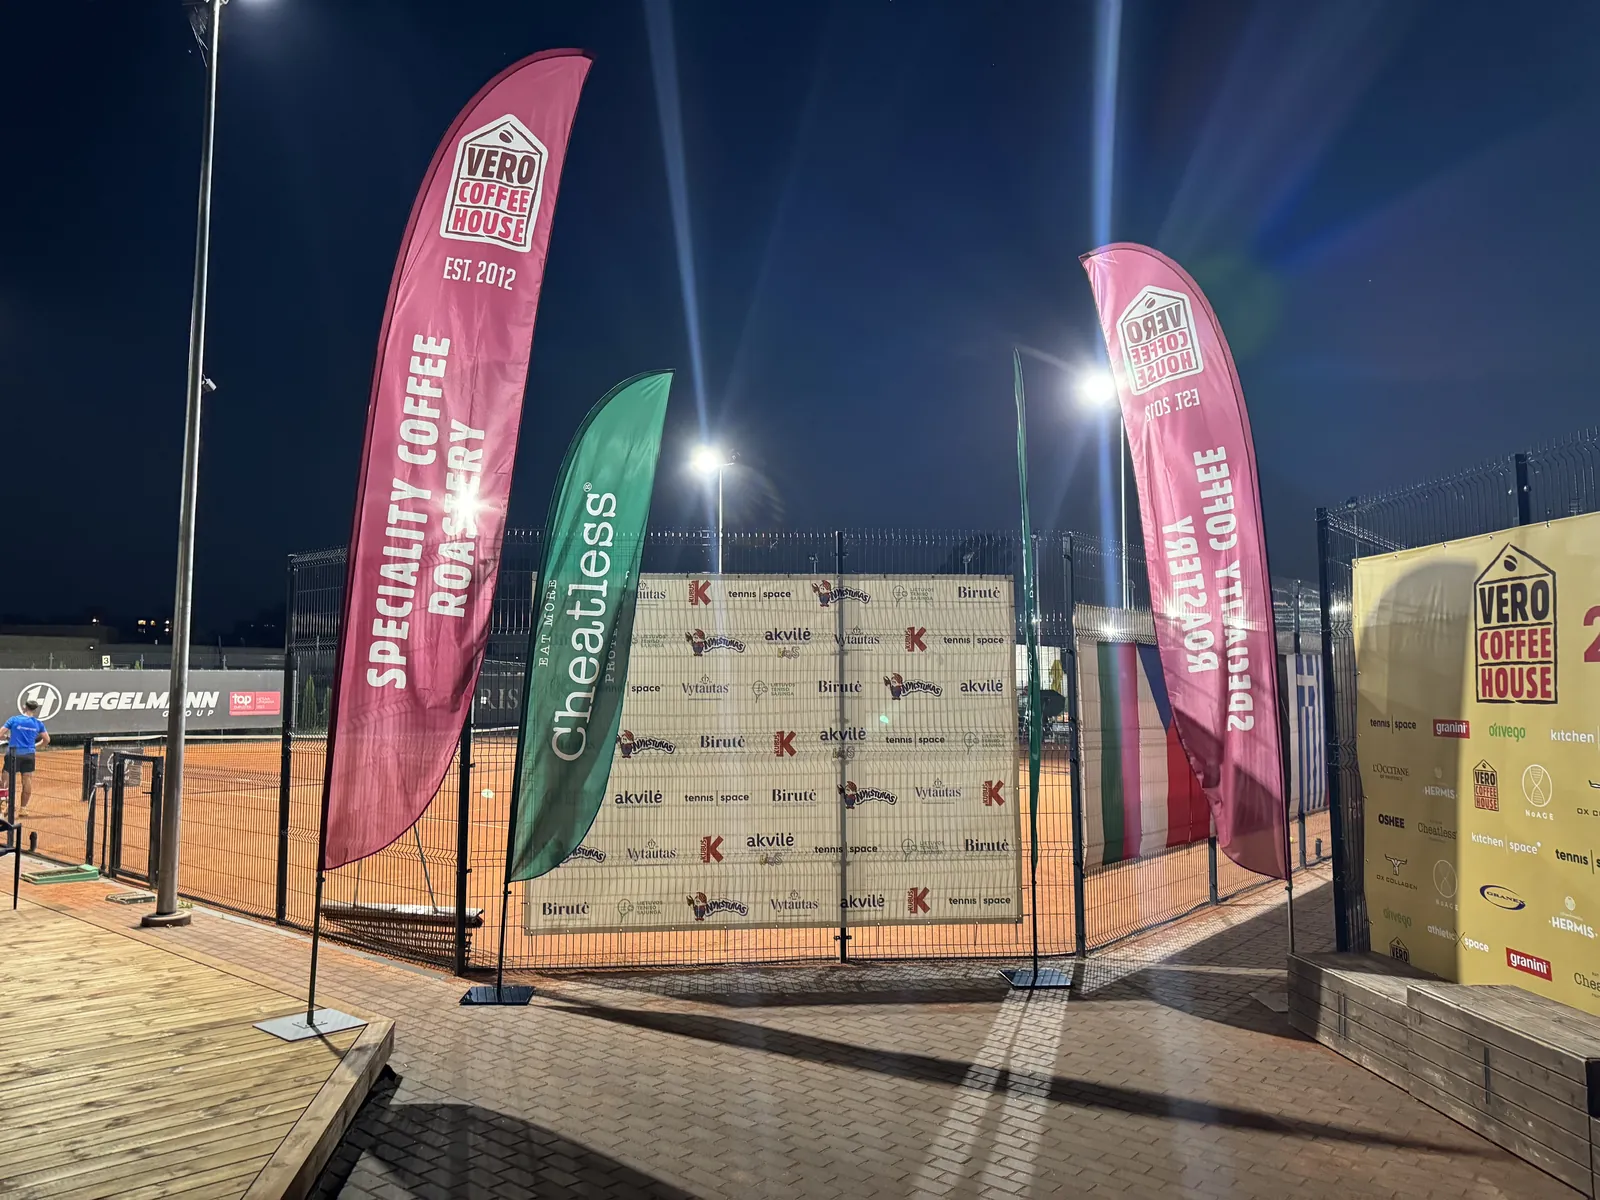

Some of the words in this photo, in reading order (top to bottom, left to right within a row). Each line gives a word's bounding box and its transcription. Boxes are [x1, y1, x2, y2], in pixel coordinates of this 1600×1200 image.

[467, 147, 536, 185] VERO
[458, 181, 530, 213] COFFEE
[452, 208, 525, 243] HOUSE
[443, 256, 472, 282] EST.
[476, 260, 516, 291] 2012
[397, 333, 451, 466] COFFEE
[427, 417, 485, 618] ROASTERY
[366, 477, 432, 690] SPECIALITY
[728, 589, 756, 598] tennis
[763, 590, 791, 599] space
[958, 586, 1000, 598] Birutė
[544, 580, 557, 627] MORE
[1479, 580, 1550, 624] VERO
[764, 628, 811, 640] akvilė
[834, 634, 880, 647] Vytautas
[977, 637, 1004, 645] space
[1480, 628, 1552, 661] COFFEE
[538, 634, 551, 667] EAT
[103, 657, 110, 665] 3
[631, 684, 661, 694] space
[682, 682, 729, 695] Vytautas
[818, 680, 862, 693] Birutė
[960, 679, 1003, 692] akvilė
[1481, 667, 1552, 699] HOUSE
[65, 691, 219, 711] HEGELMNN
[232, 693, 251, 705] top
[1370, 719, 1390, 728] tennis
[1395, 721, 1416, 731] space
[1436, 721, 1468, 734] granini
[820, 727, 866, 741] akvilė
[1551, 729, 1595, 743] kitchen
[700, 735, 745, 748] Birutė
[918, 737, 945, 745] space
[1475, 771, 1496, 785] VERO
[615, 790, 662, 804] akvilė
[684, 793, 714, 802] tennis
[720, 793, 749, 803] space
[772, 788, 817, 801] Birutė
[915, 786, 961, 799] Vytautas
[1424, 786, 1456, 799] HERMIS
[1475, 785, 1497, 798] COFFEE
[1476, 797, 1498, 810] HOUSE
[1378, 813, 1405, 829] OSHEE
[747, 833, 794, 847] akvilė
[965, 839, 1009, 851] Birutė
[1471, 832, 1504, 848] kitchen
[1509, 841, 1538, 855] space
[628, 848, 676, 861] Vytautas
[814, 845, 843, 854] tennis
[850, 845, 878, 854] space
[1555, 848, 1589, 865] tennis
[771, 899, 818, 912] Vytautas
[840, 894, 885, 908] akvilė
[949, 897, 977, 905] tennis
[983, 897, 1011, 906] space
[543, 901, 589, 915] Birutė
[1551, 916, 1595, 939] HERMIS
[1464, 936, 1489, 952] space
[1510, 953, 1548, 974] granini
